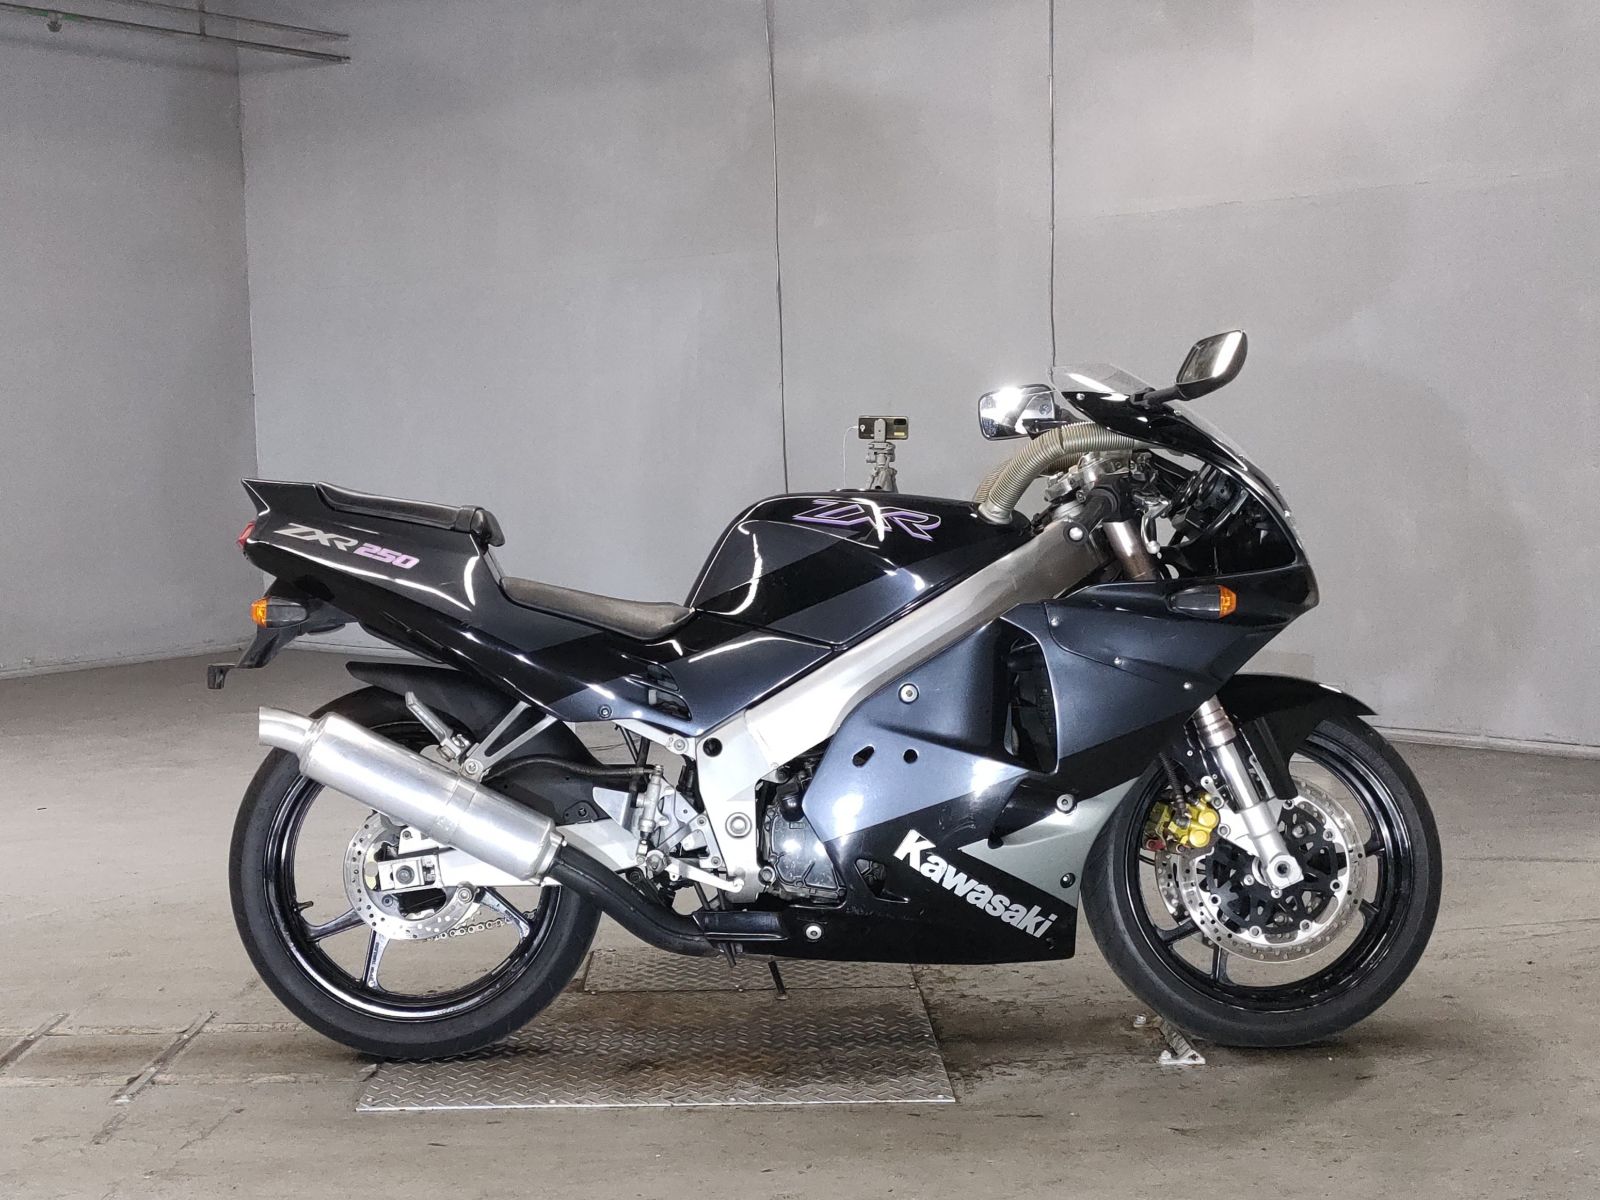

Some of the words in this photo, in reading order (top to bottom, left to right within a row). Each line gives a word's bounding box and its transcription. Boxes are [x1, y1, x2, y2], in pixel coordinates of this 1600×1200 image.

[273, 522, 359, 551] ZXR
[353, 542, 420, 569] 250
[893, 829, 1058, 938] Kawasaki
